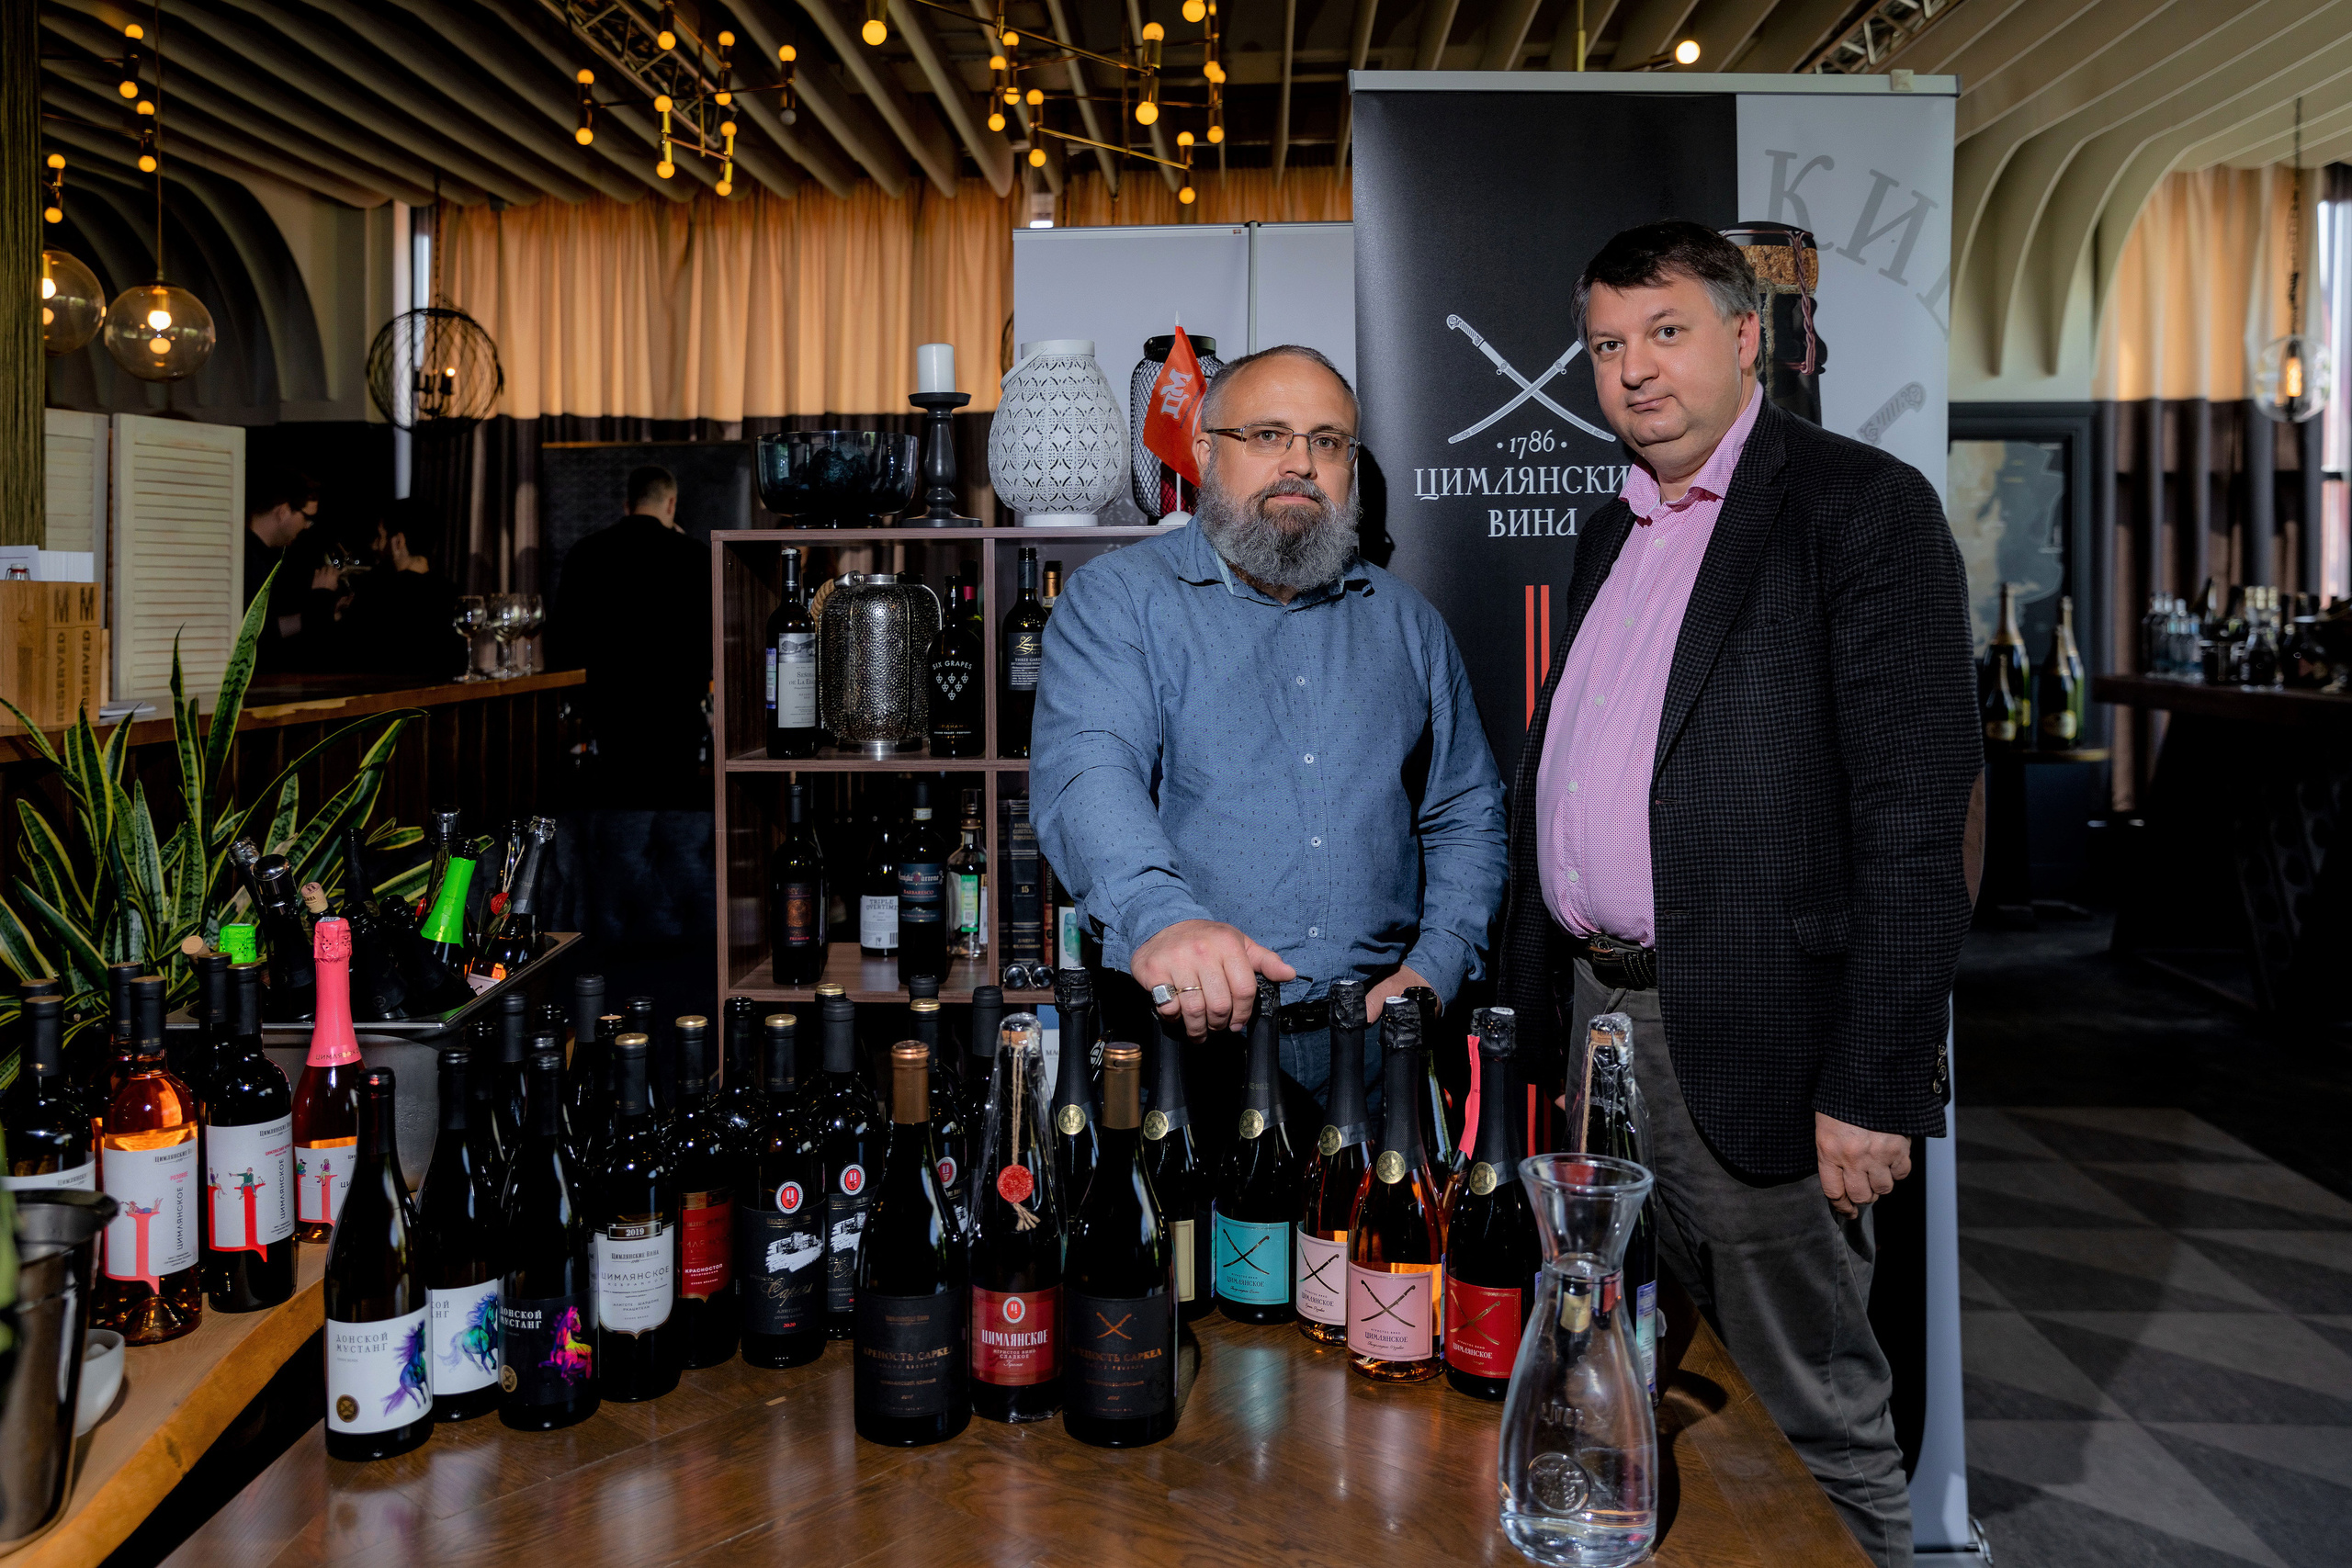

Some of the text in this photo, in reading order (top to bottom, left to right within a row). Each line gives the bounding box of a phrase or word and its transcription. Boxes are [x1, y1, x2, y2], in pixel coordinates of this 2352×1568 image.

[1510, 429, 1555, 459] 1786
[1414, 465, 1629, 501] ЦИМЛЯНСКИ
[1487, 508, 1577, 537] ВИНА
[82, 630, 91, 714] ESERVED
[932, 660, 972, 671] SIX GRAPES
[627, 1228, 644, 1236] 2019
[602, 1266, 670, 1280] ЦИМЛЯНСКОЕ
[684, 1264, 723, 1273] КРАСНОСТОП
[1227, 1276, 1264, 1287] ЦИМЛЯНСКОЕ
[1301, 1292, 1334, 1307] ЦИМЛЯНСКОЕ
[500, 1306, 542, 1319] ДОНСКОЙ
[500, 1315, 542, 1329] МУСТАНГ
[336, 1332, 388, 1343] ДОНСКОЙ
[981, 1328, 1048, 1347] ЦИМЛЯНСКОЕ
[1364, 1331, 1408, 1343] ЦИМЛЯНСКОЕ
[336, 1343, 388, 1353] МУСТАНГ
[1453, 1342, 1493, 1359] ЦИМЛЯНСКОЕ
